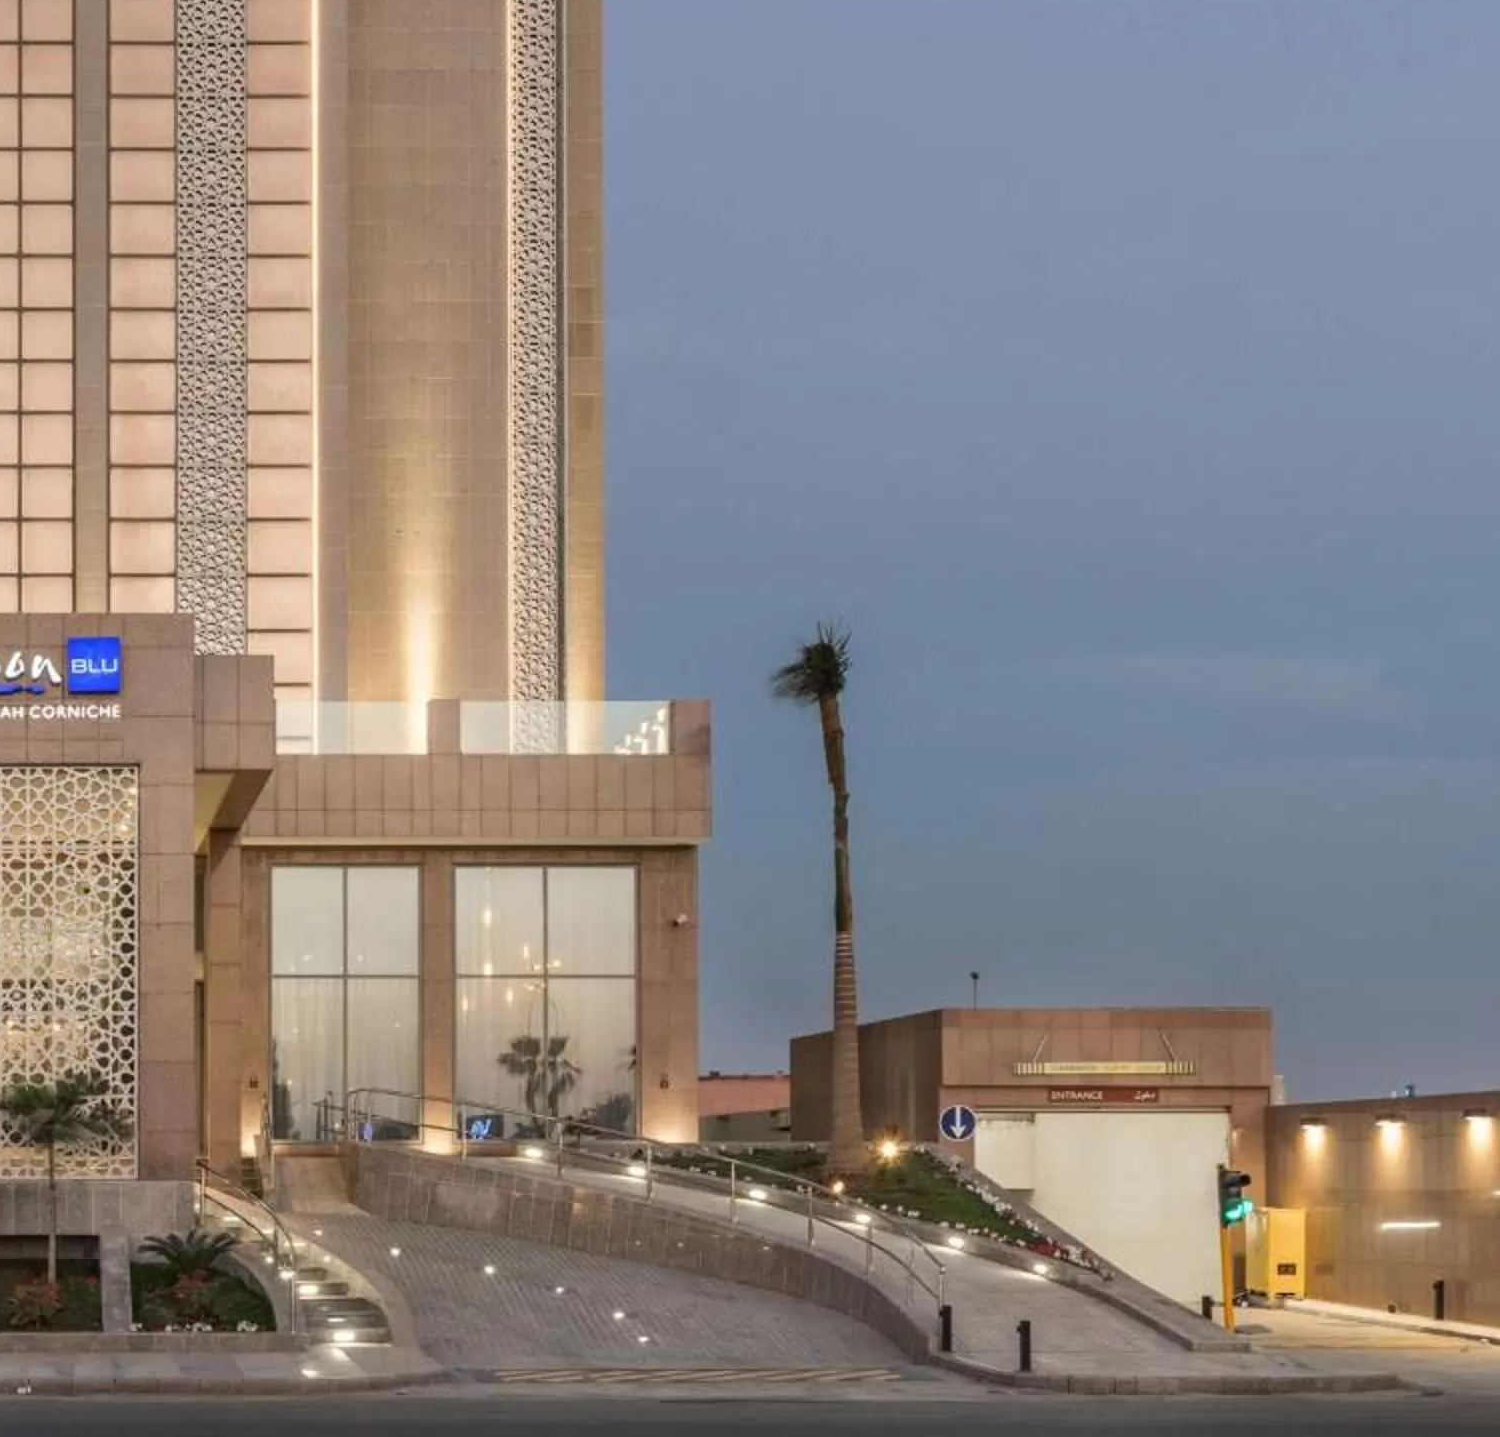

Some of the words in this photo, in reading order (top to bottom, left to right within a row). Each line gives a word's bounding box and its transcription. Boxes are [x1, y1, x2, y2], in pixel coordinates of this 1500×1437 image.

[71, 657, 119, 674] BLU
[29, 704, 122, 719] CORNICHE
[1051, 1090, 1104, 1100] ENTRANCE
